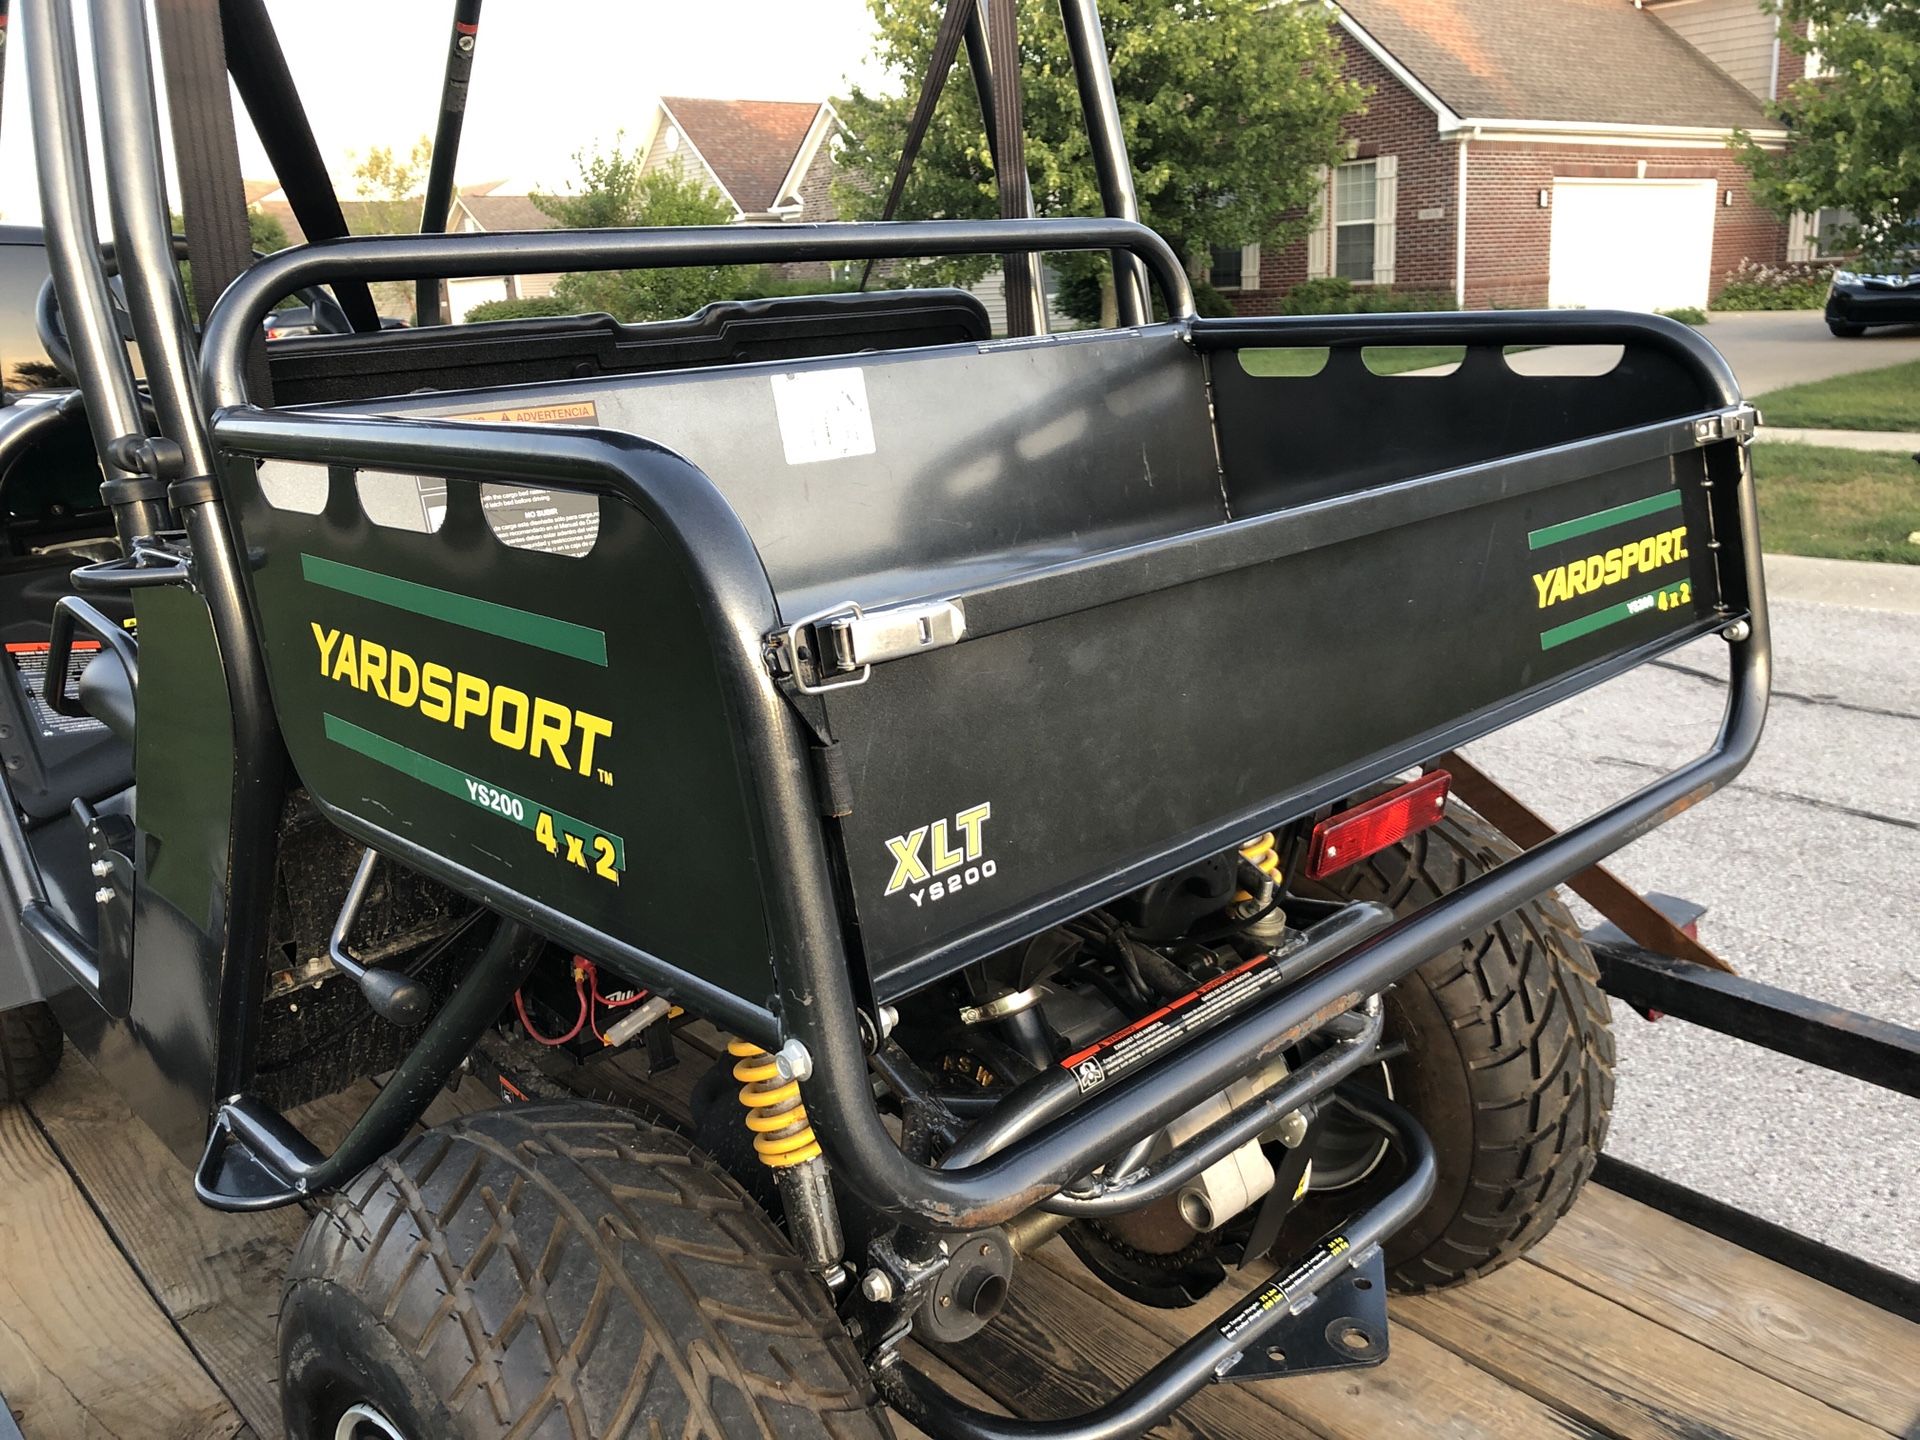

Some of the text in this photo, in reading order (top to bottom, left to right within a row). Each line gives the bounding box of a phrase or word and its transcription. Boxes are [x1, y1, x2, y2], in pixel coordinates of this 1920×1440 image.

[516, 407, 590, 422] ADVERTENCIA
[1532, 526, 1687, 609] YARDSPORT
[310, 622, 613, 777] YARDSPORT
[465, 779, 523, 821] YS200
[884, 802, 990, 896] XLT
[910, 860, 996, 907] YS200
